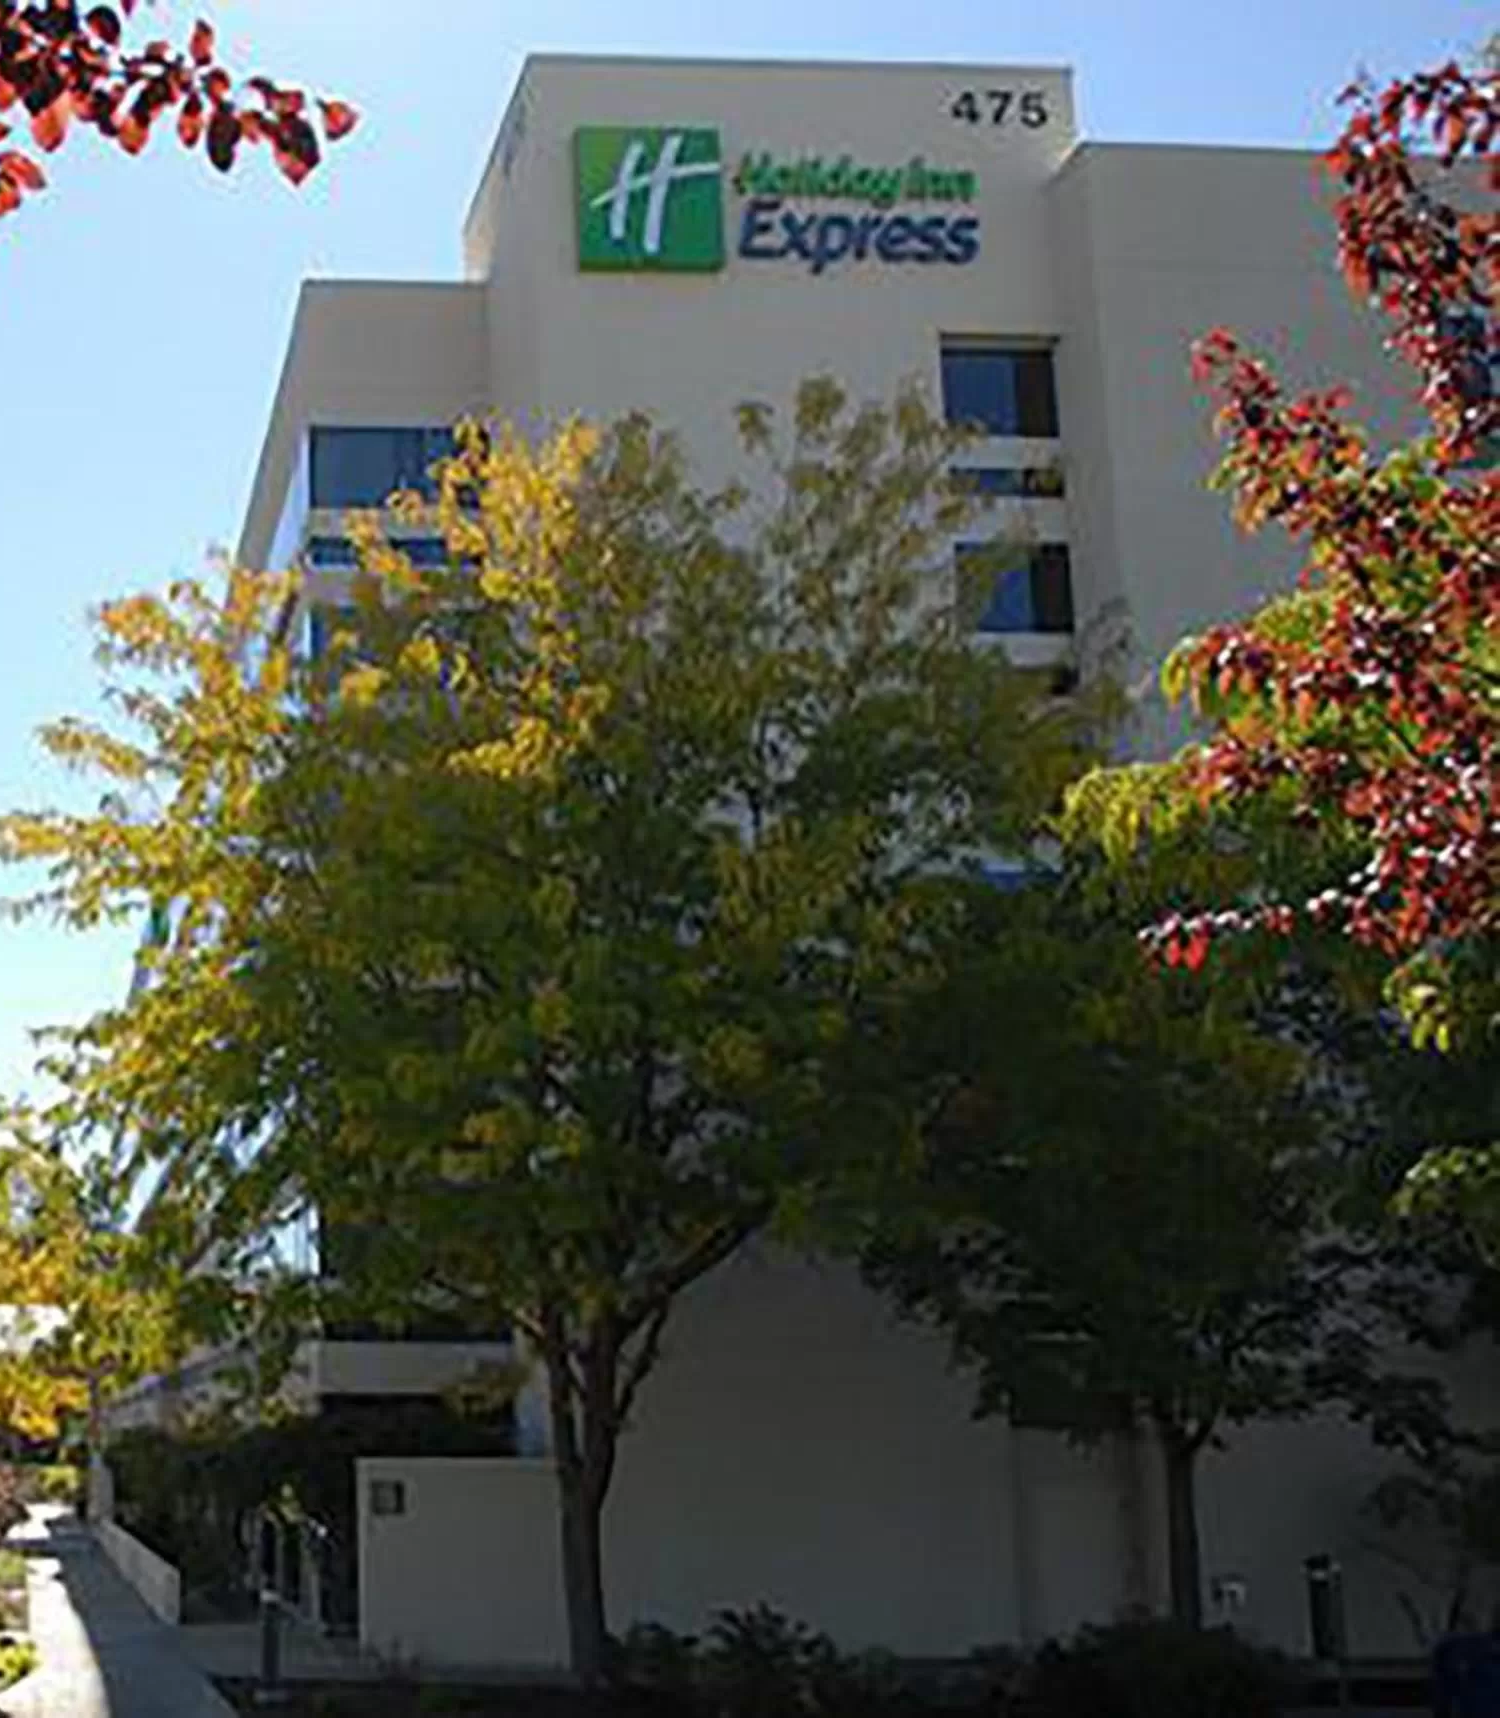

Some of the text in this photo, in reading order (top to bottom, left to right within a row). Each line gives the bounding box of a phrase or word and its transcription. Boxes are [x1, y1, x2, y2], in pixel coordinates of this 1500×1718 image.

[950, 90, 1049, 129] 475
[589, 134, 721, 254] H
[733, 152, 978, 207] Holiday Inn
[739, 201, 980, 275] Express
